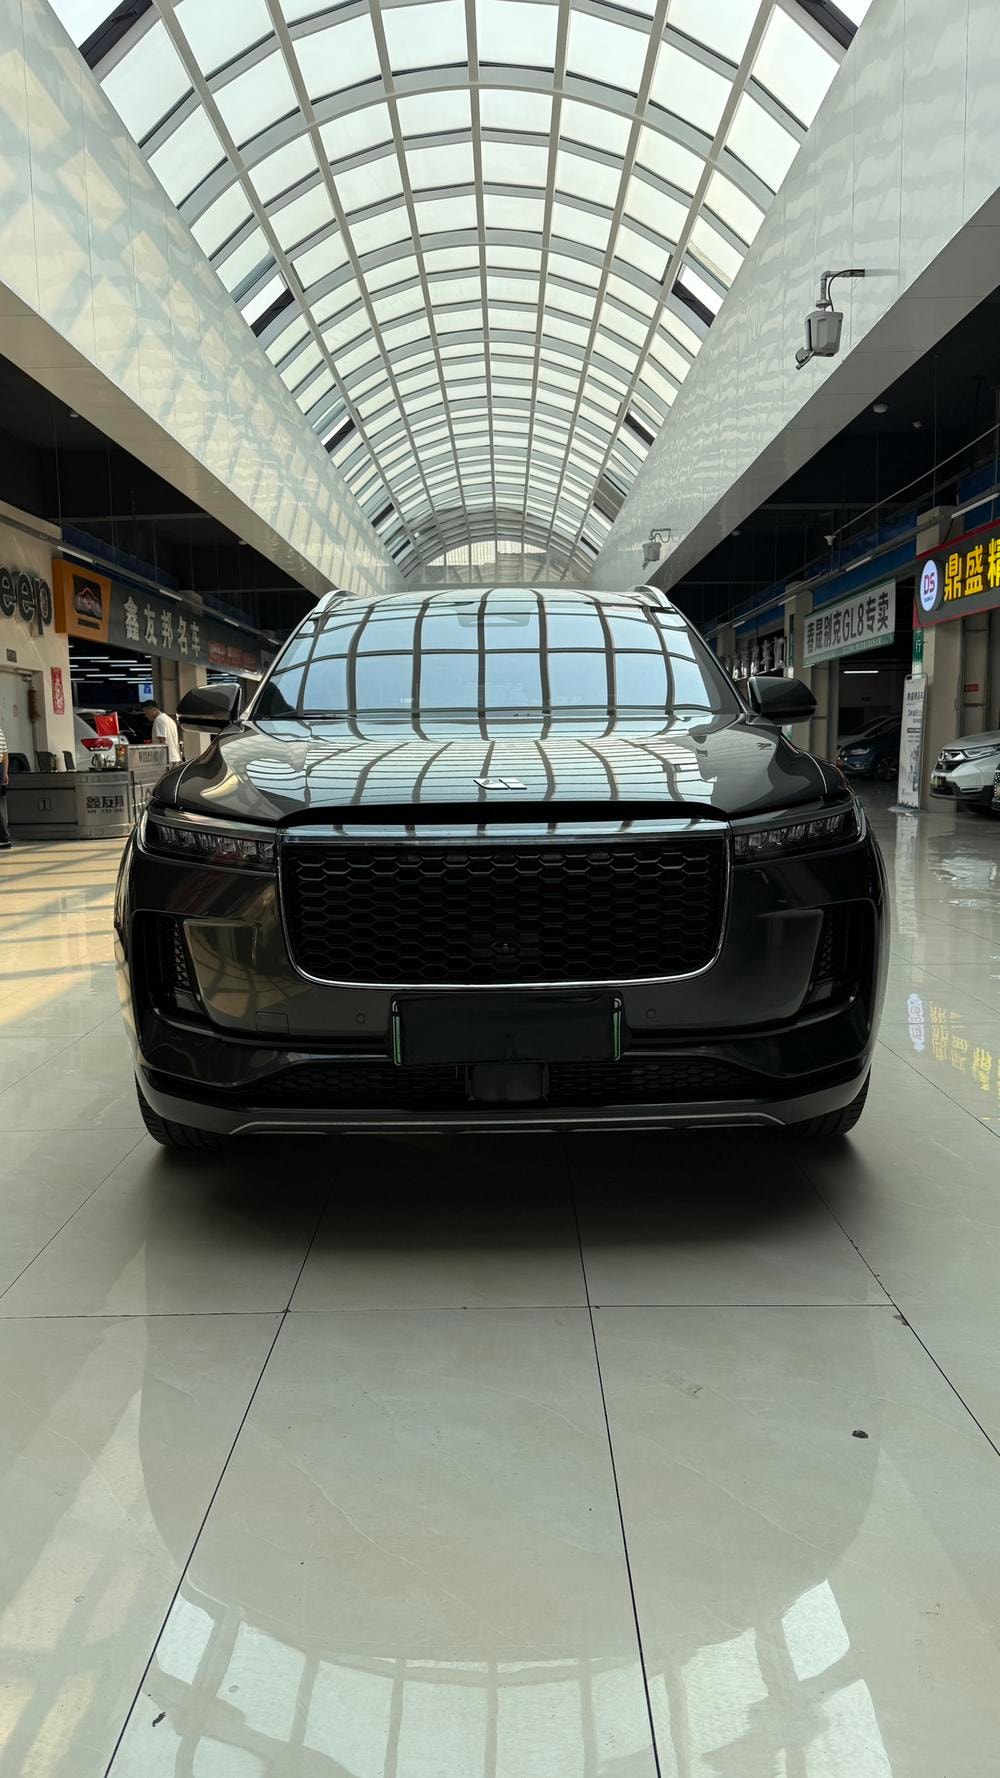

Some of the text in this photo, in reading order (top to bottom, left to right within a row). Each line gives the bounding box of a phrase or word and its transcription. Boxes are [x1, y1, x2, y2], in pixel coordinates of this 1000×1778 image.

[124, 596, 200, 657] 鑫友邦名车
